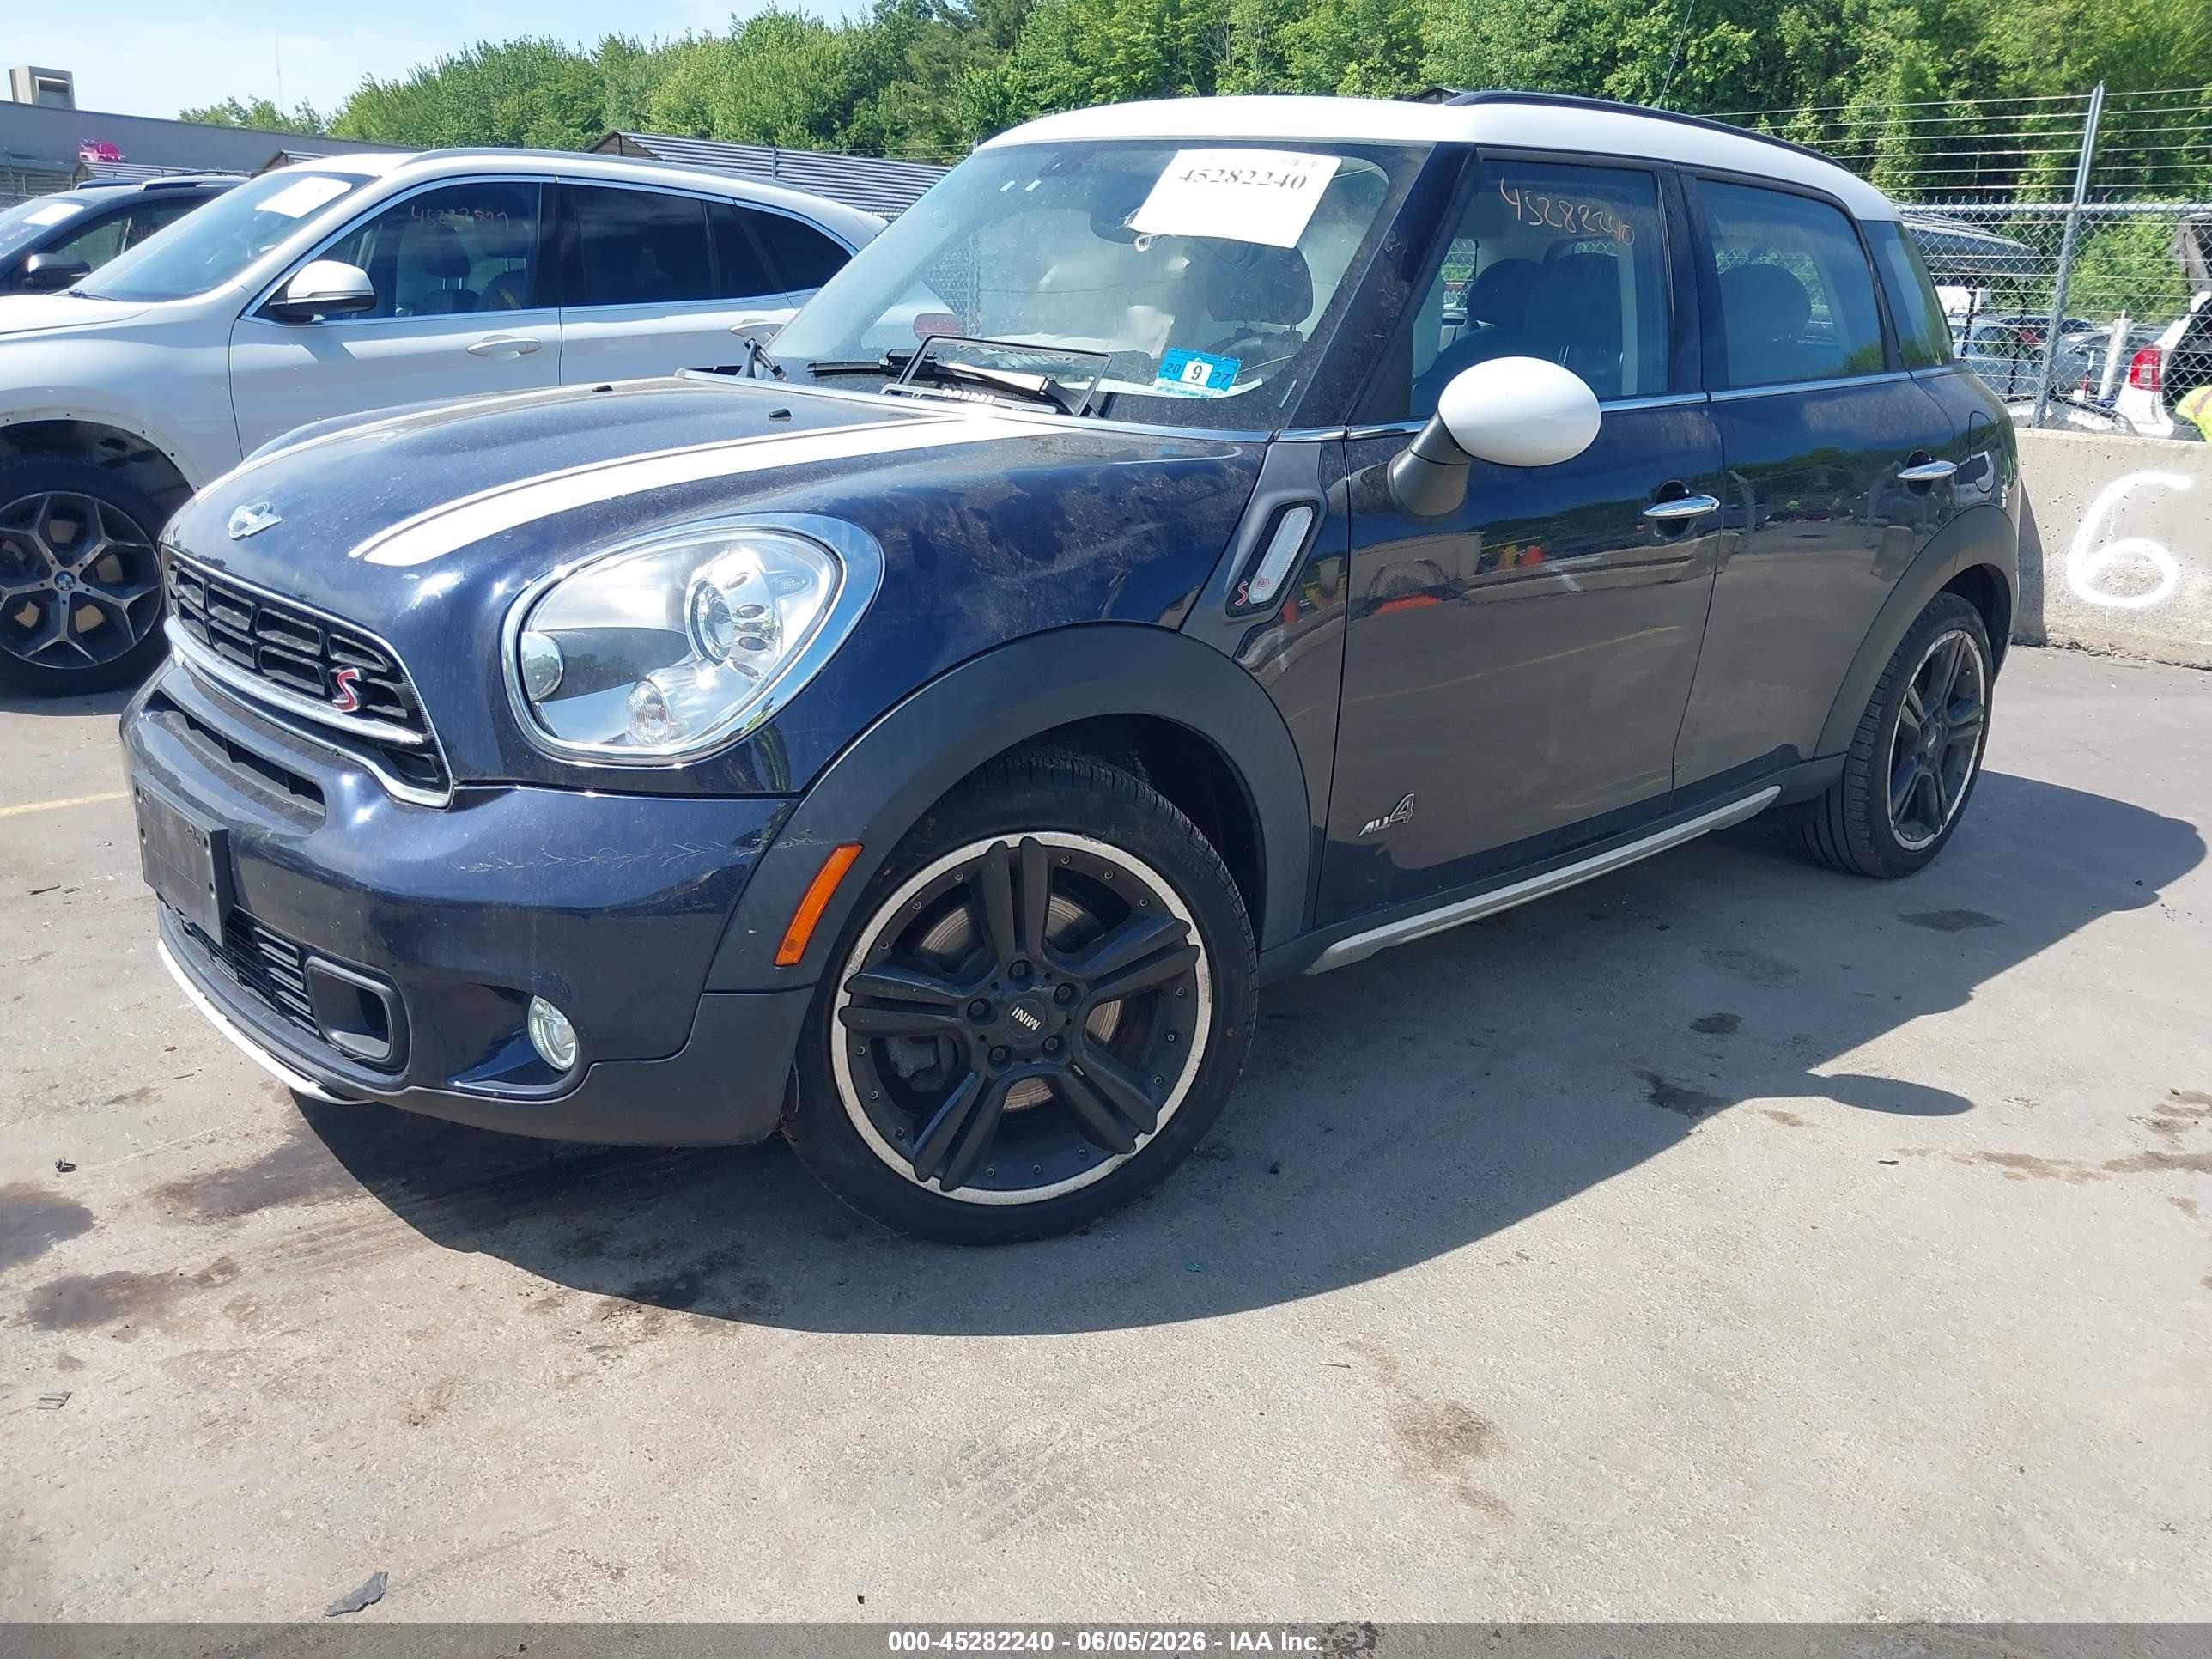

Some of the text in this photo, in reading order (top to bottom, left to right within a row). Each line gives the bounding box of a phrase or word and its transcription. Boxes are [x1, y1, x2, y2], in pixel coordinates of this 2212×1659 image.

[1178, 168, 1308, 191] 45282240
[1499, 177, 1635, 246] 45282240
[1190, 364, 1203, 380] 9
[941, 388, 995, 404] MINI
[2067, 471, 2194, 608] 6
[331, 666, 361, 713] S
[1358, 792, 1415, 837] ALL4
[1011, 1006, 1041, 1031] MINI
